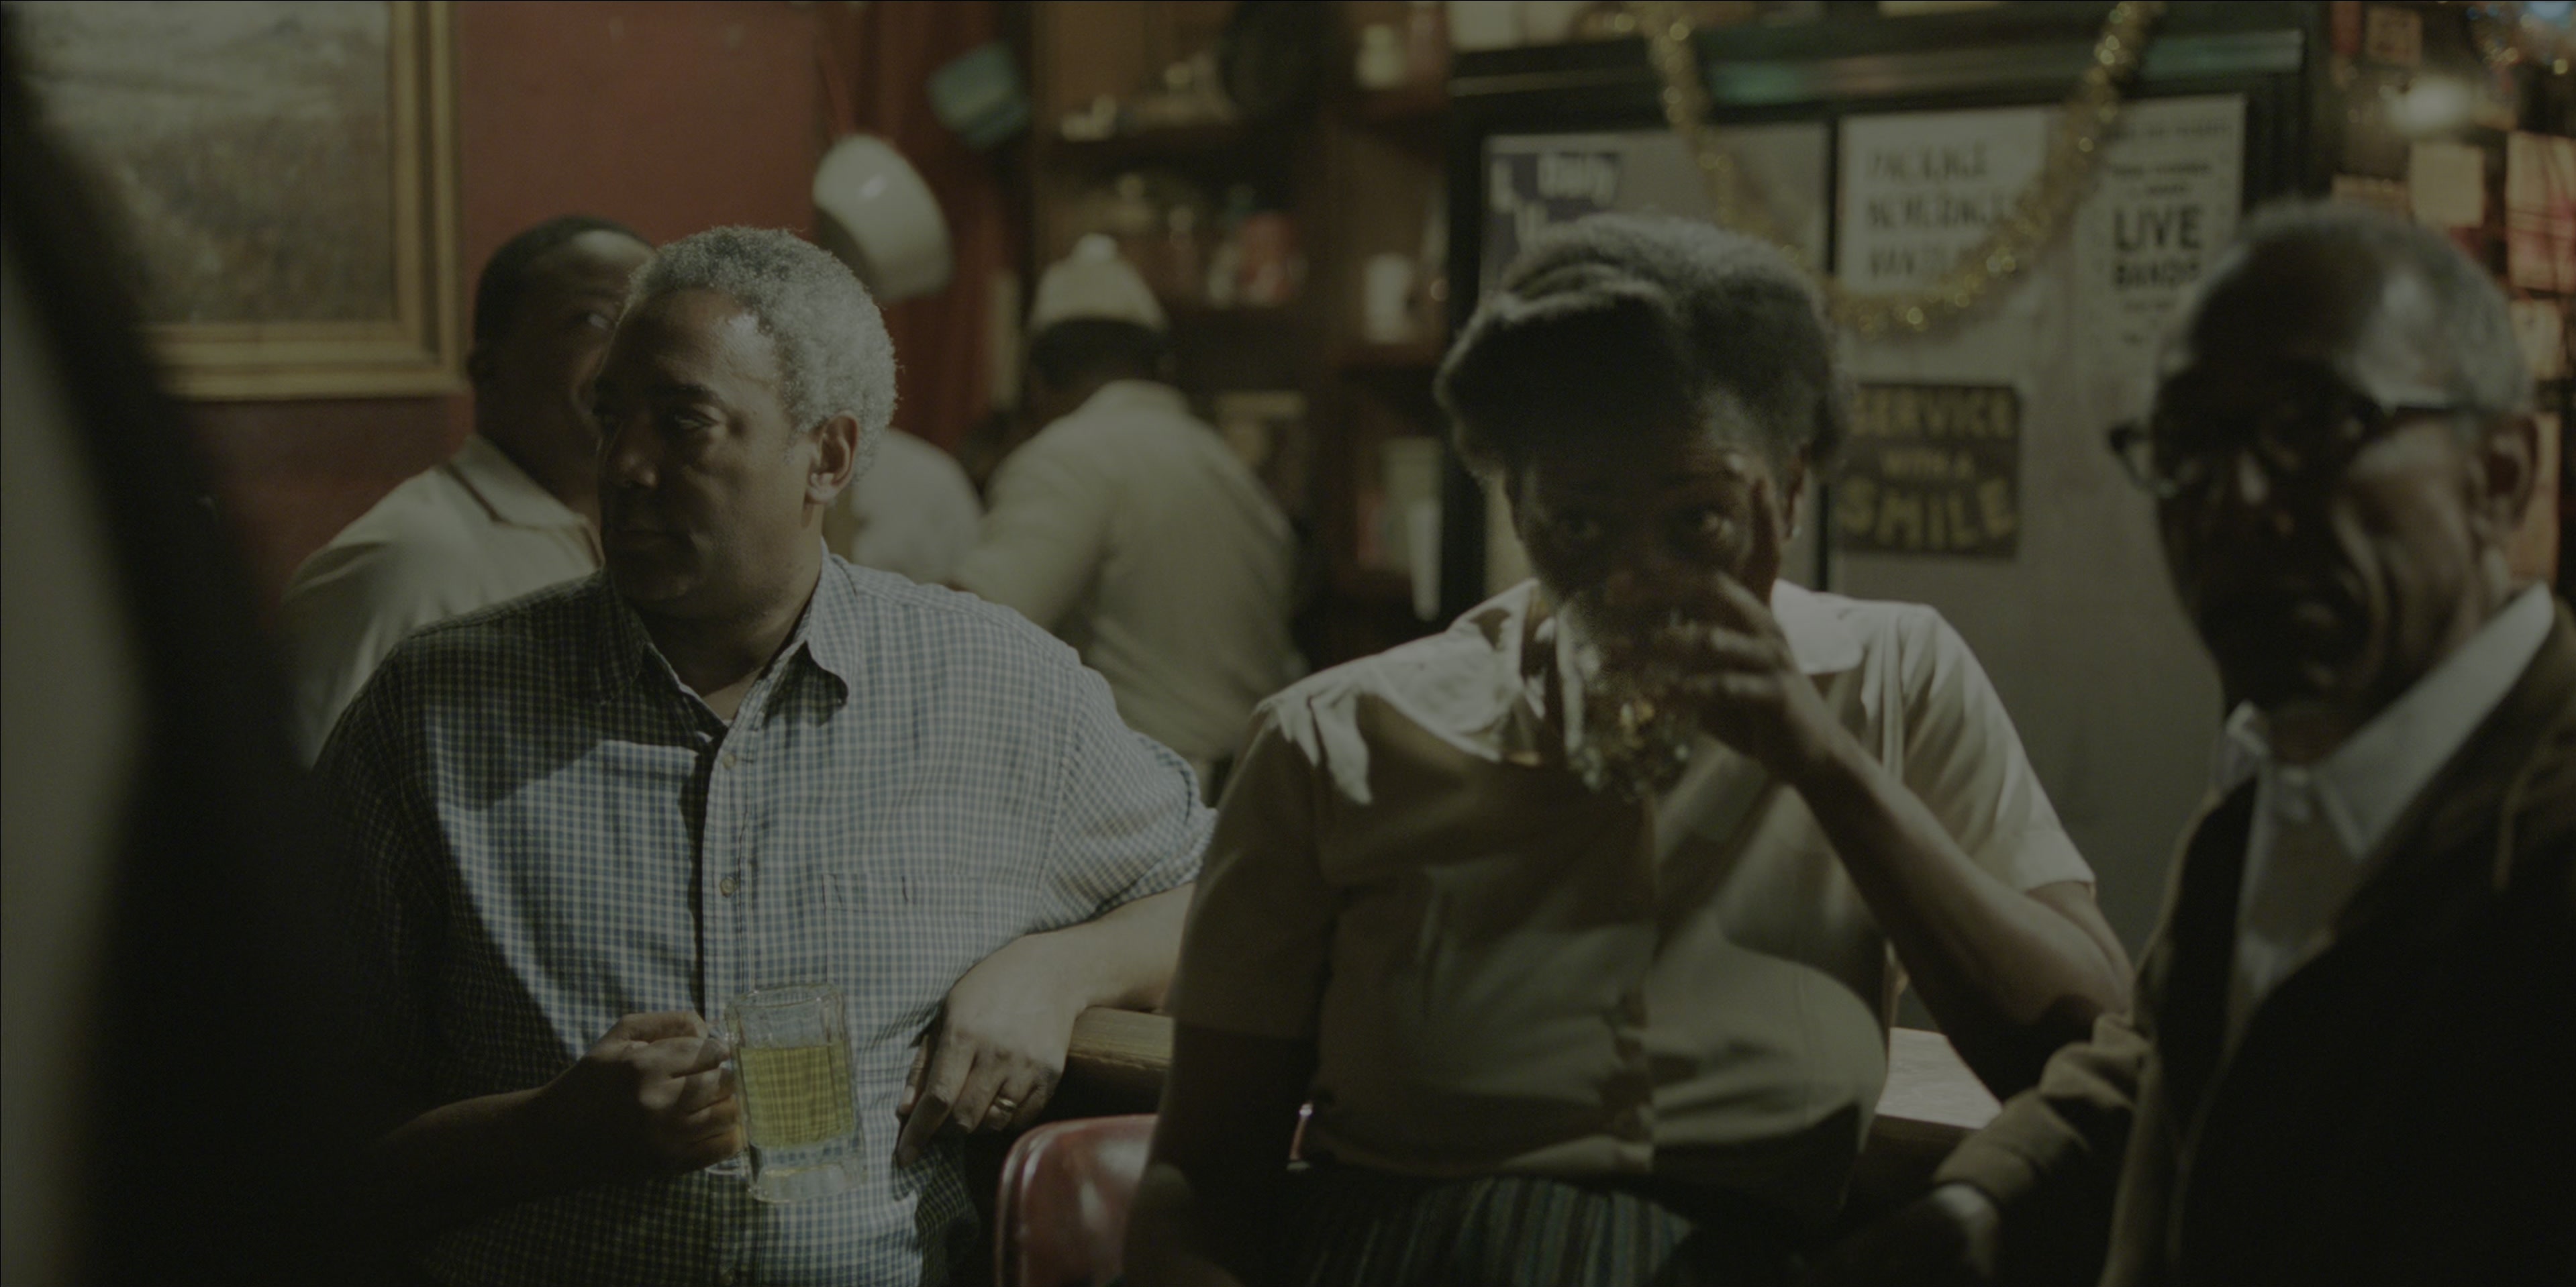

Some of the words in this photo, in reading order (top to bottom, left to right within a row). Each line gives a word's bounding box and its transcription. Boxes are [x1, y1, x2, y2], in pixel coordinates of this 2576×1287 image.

[2113, 203, 2204, 252] LIVE
[1848, 389, 2014, 439] SERVICE
[1882, 448, 1948, 480] WITH
[1837, 475, 2014, 550] SMILE
